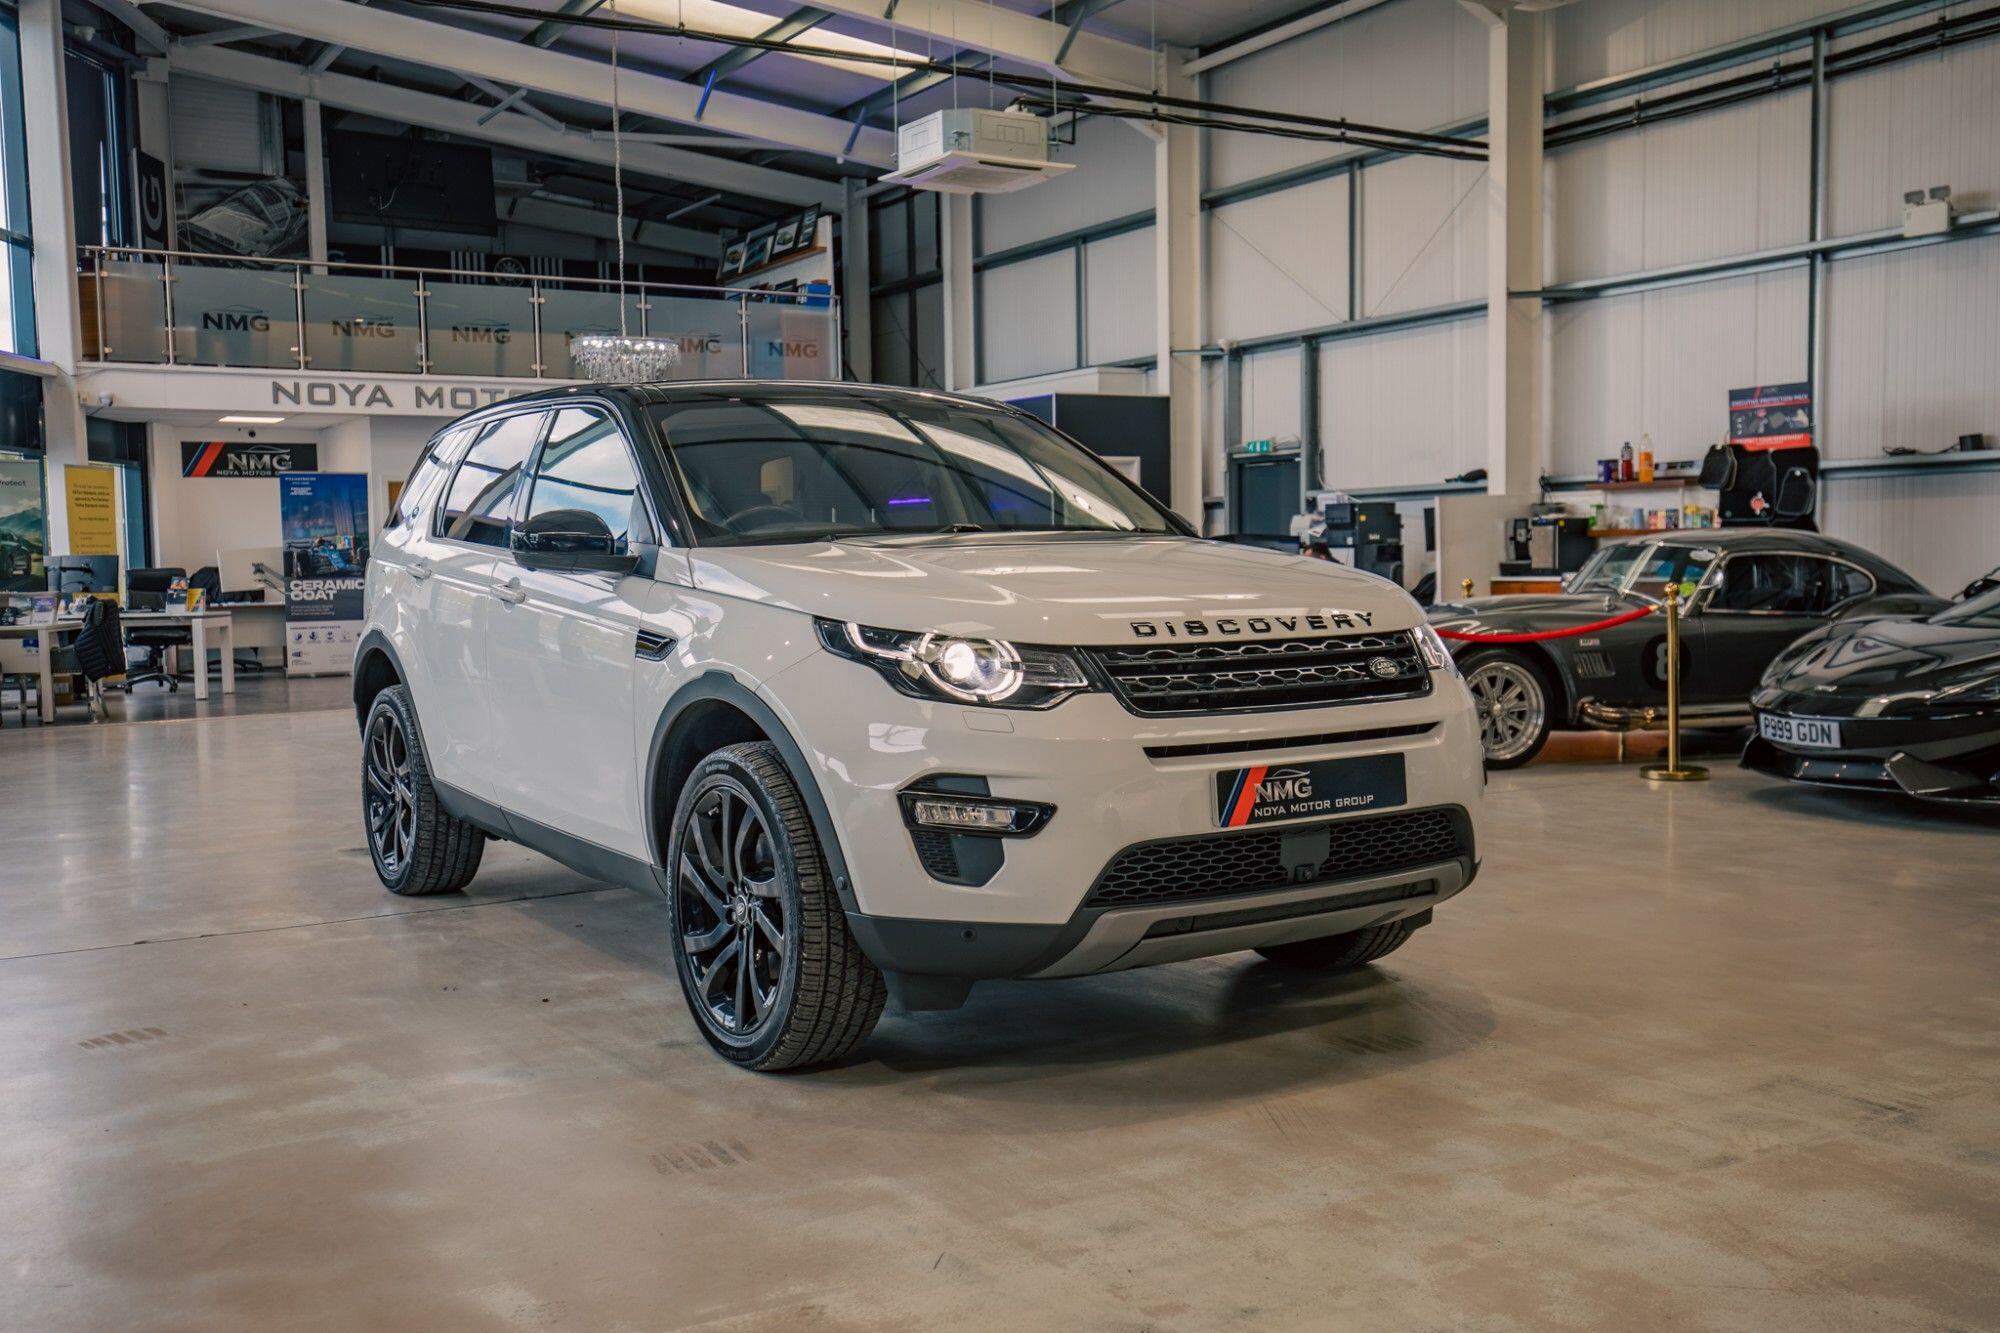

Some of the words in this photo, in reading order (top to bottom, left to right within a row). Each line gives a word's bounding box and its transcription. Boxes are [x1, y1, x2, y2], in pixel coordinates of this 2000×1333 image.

[202, 312, 270, 332] NMG
[331, 320, 395, 338] NMG
[452, 326, 511, 344] NMG
[768, 341, 818, 358] NMG
[272, 381, 394, 408] NOYA
[227, 453, 292, 470] NMG
[0, 479, 26, 487] rotect
[290, 579, 365, 591] CERAMIC
[290, 590, 337, 601] COAT
[1130, 612, 1373, 637] DISCOVERY
[1763, 716, 1793, 740] P999
[1796, 723, 1832, 744] GDN
[1254, 778, 1312, 803] NMG
[1254, 803, 1286, 817] NOYA
[1290, 800, 1331, 813] MOTOR
[1335, 795, 1374, 808] GROUP
